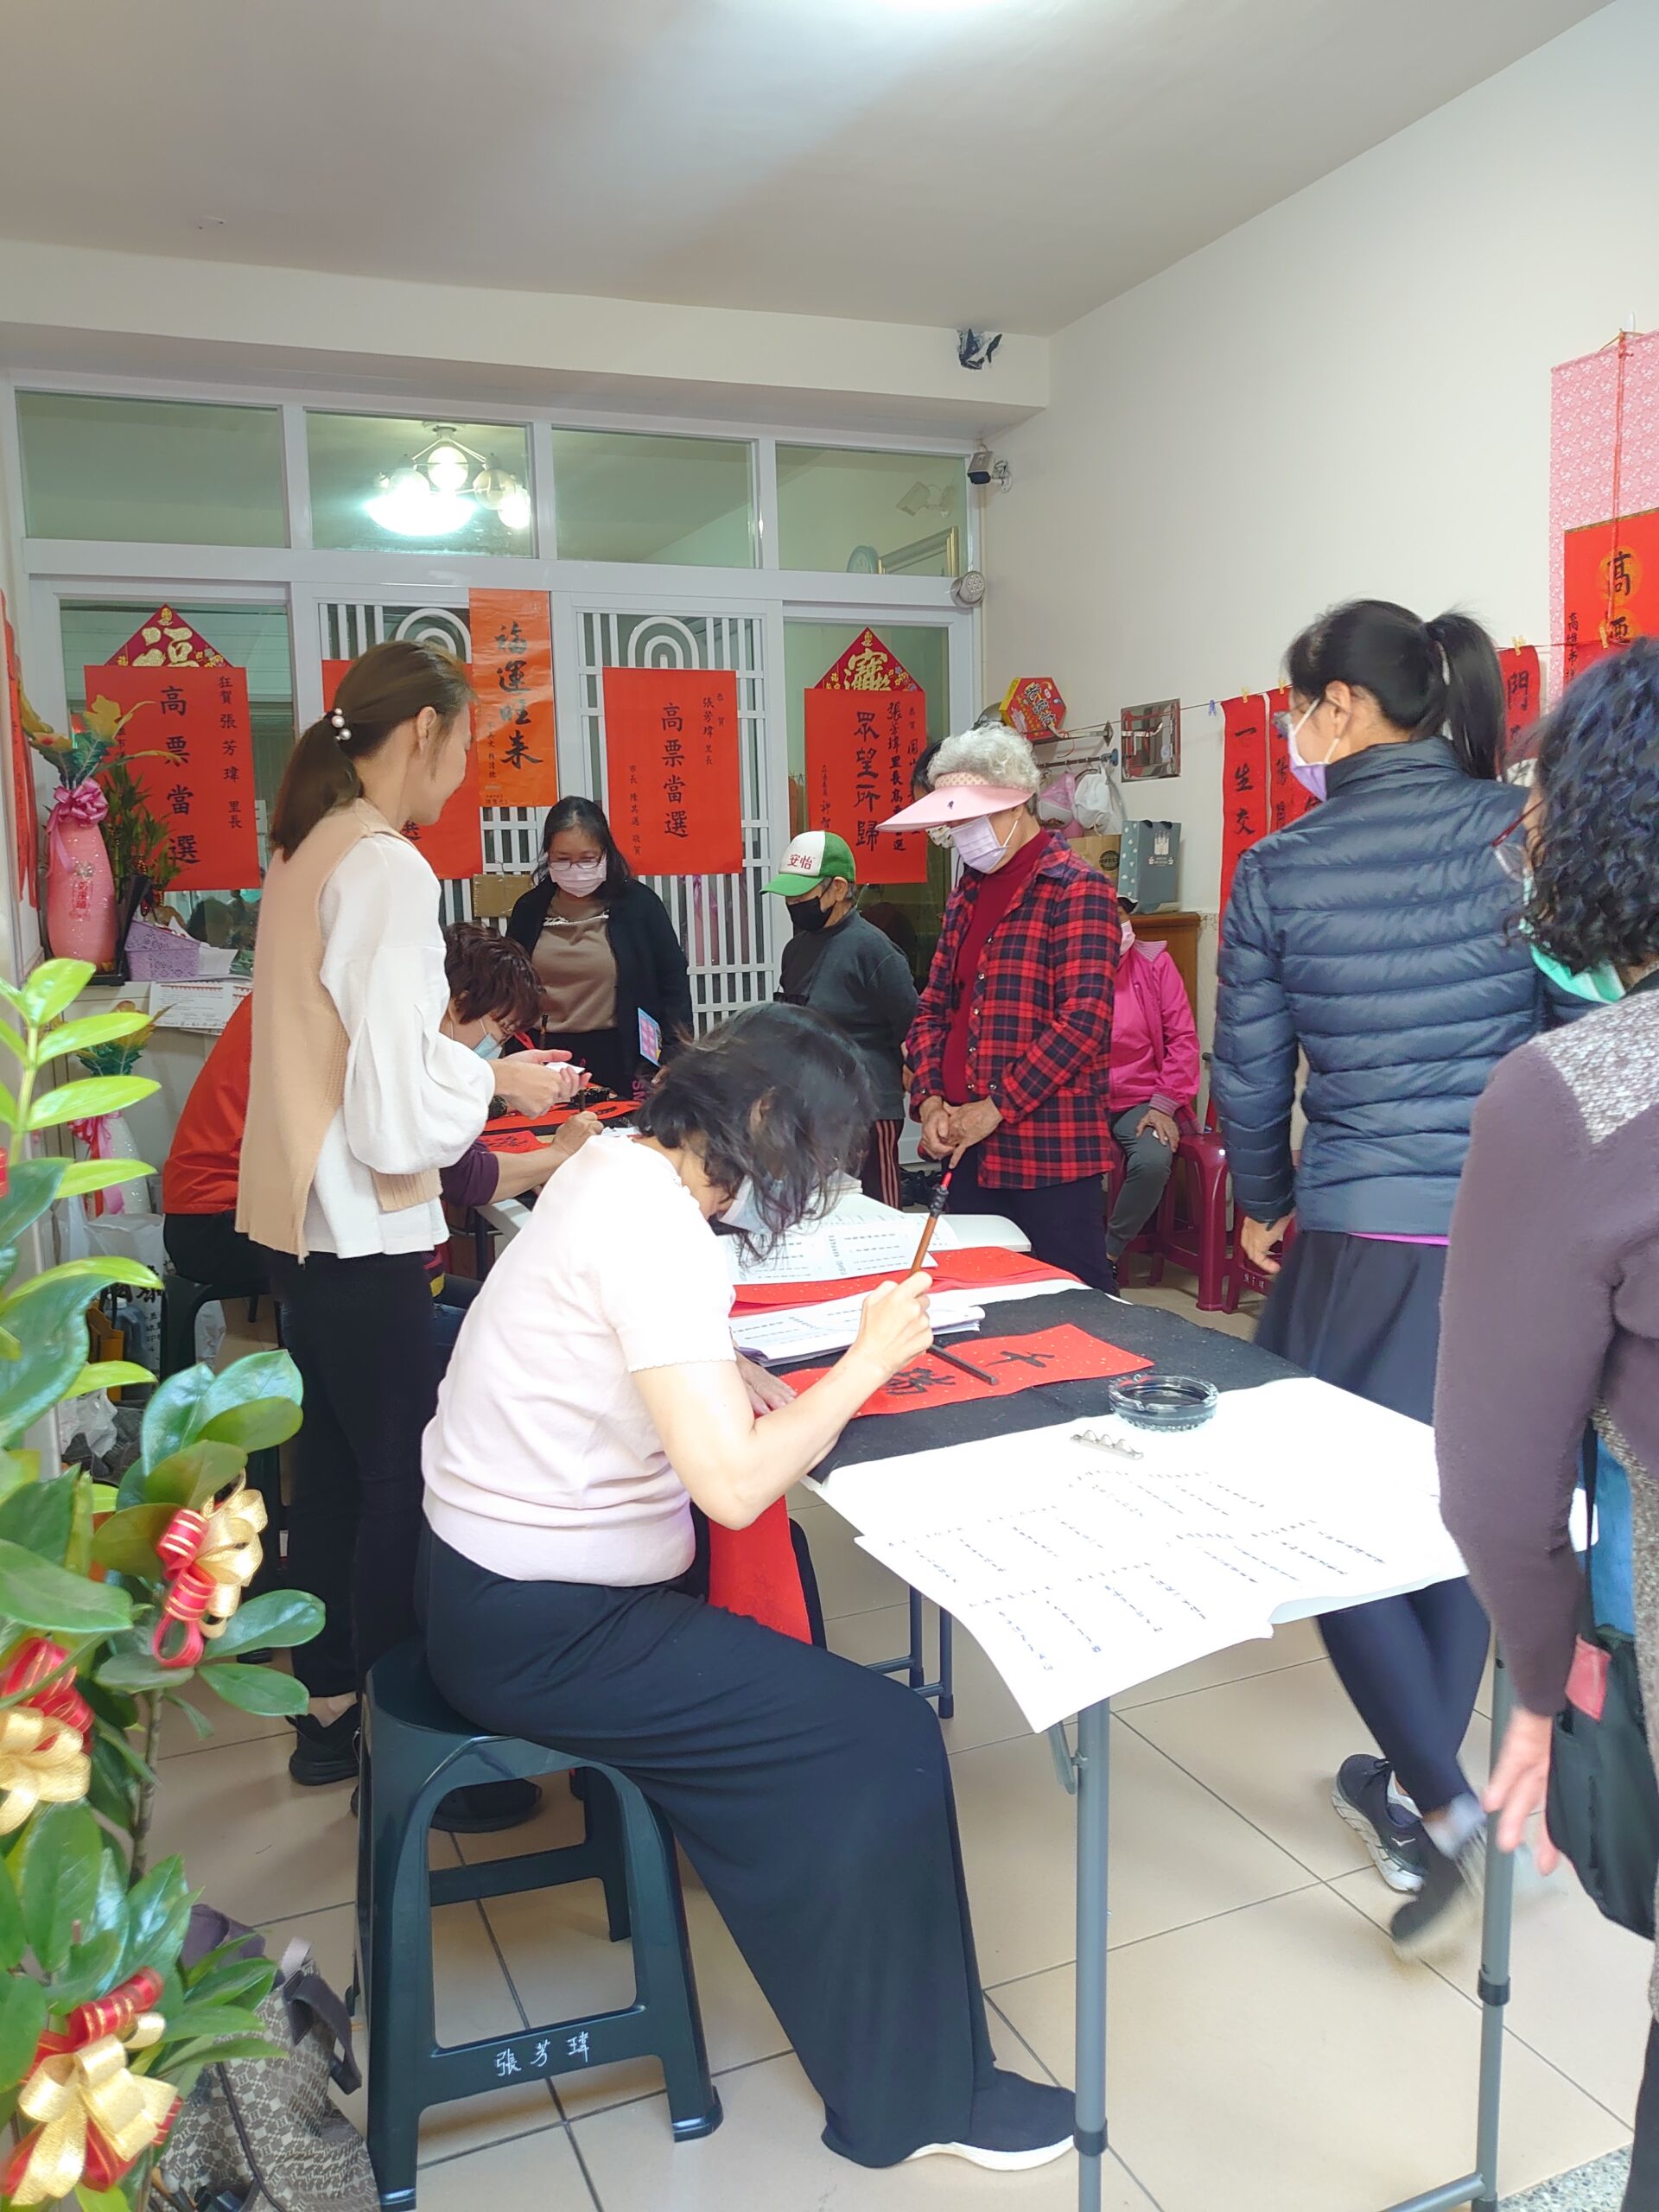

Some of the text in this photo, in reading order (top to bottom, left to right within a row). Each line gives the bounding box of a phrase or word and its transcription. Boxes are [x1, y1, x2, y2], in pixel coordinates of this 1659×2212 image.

[161, 685, 200, 864] 高票當選
[661, 702, 690, 838] 高票當選
[787, 854, 812, 869] 安怡
[496, 2031, 590, 2076] 張芳瑋
